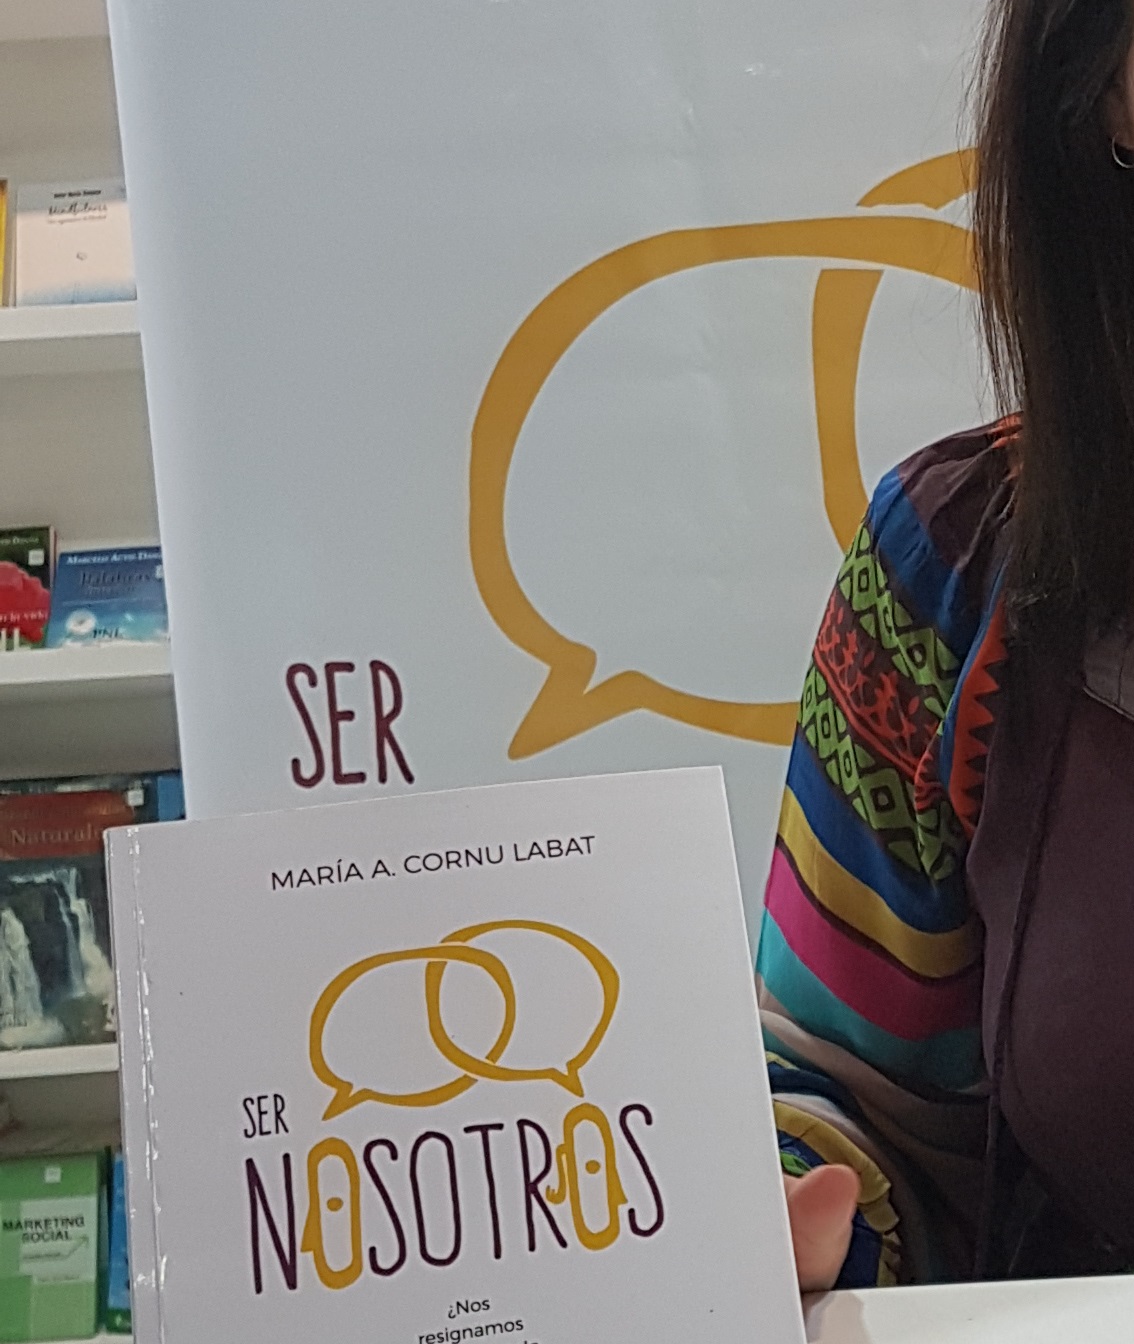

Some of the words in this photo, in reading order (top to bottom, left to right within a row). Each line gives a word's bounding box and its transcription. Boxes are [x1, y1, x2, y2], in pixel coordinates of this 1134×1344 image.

[285, 659, 416, 789] SER
[11, 823, 101, 845] Natural
[271, 858, 364, 891] MARÍA
[371, 858, 397, 878] A.
[403, 844, 504, 874] CORNU
[513, 836, 596, 863] LABAT
[243, 1093, 290, 1138] SER
[245, 1102, 665, 1295] NOSOTROS
[2, 1215, 86, 1232] MARKETING
[22, 1229, 72, 1244] SOCIAL
[447, 1298, 491, 1319] ¿Nos
